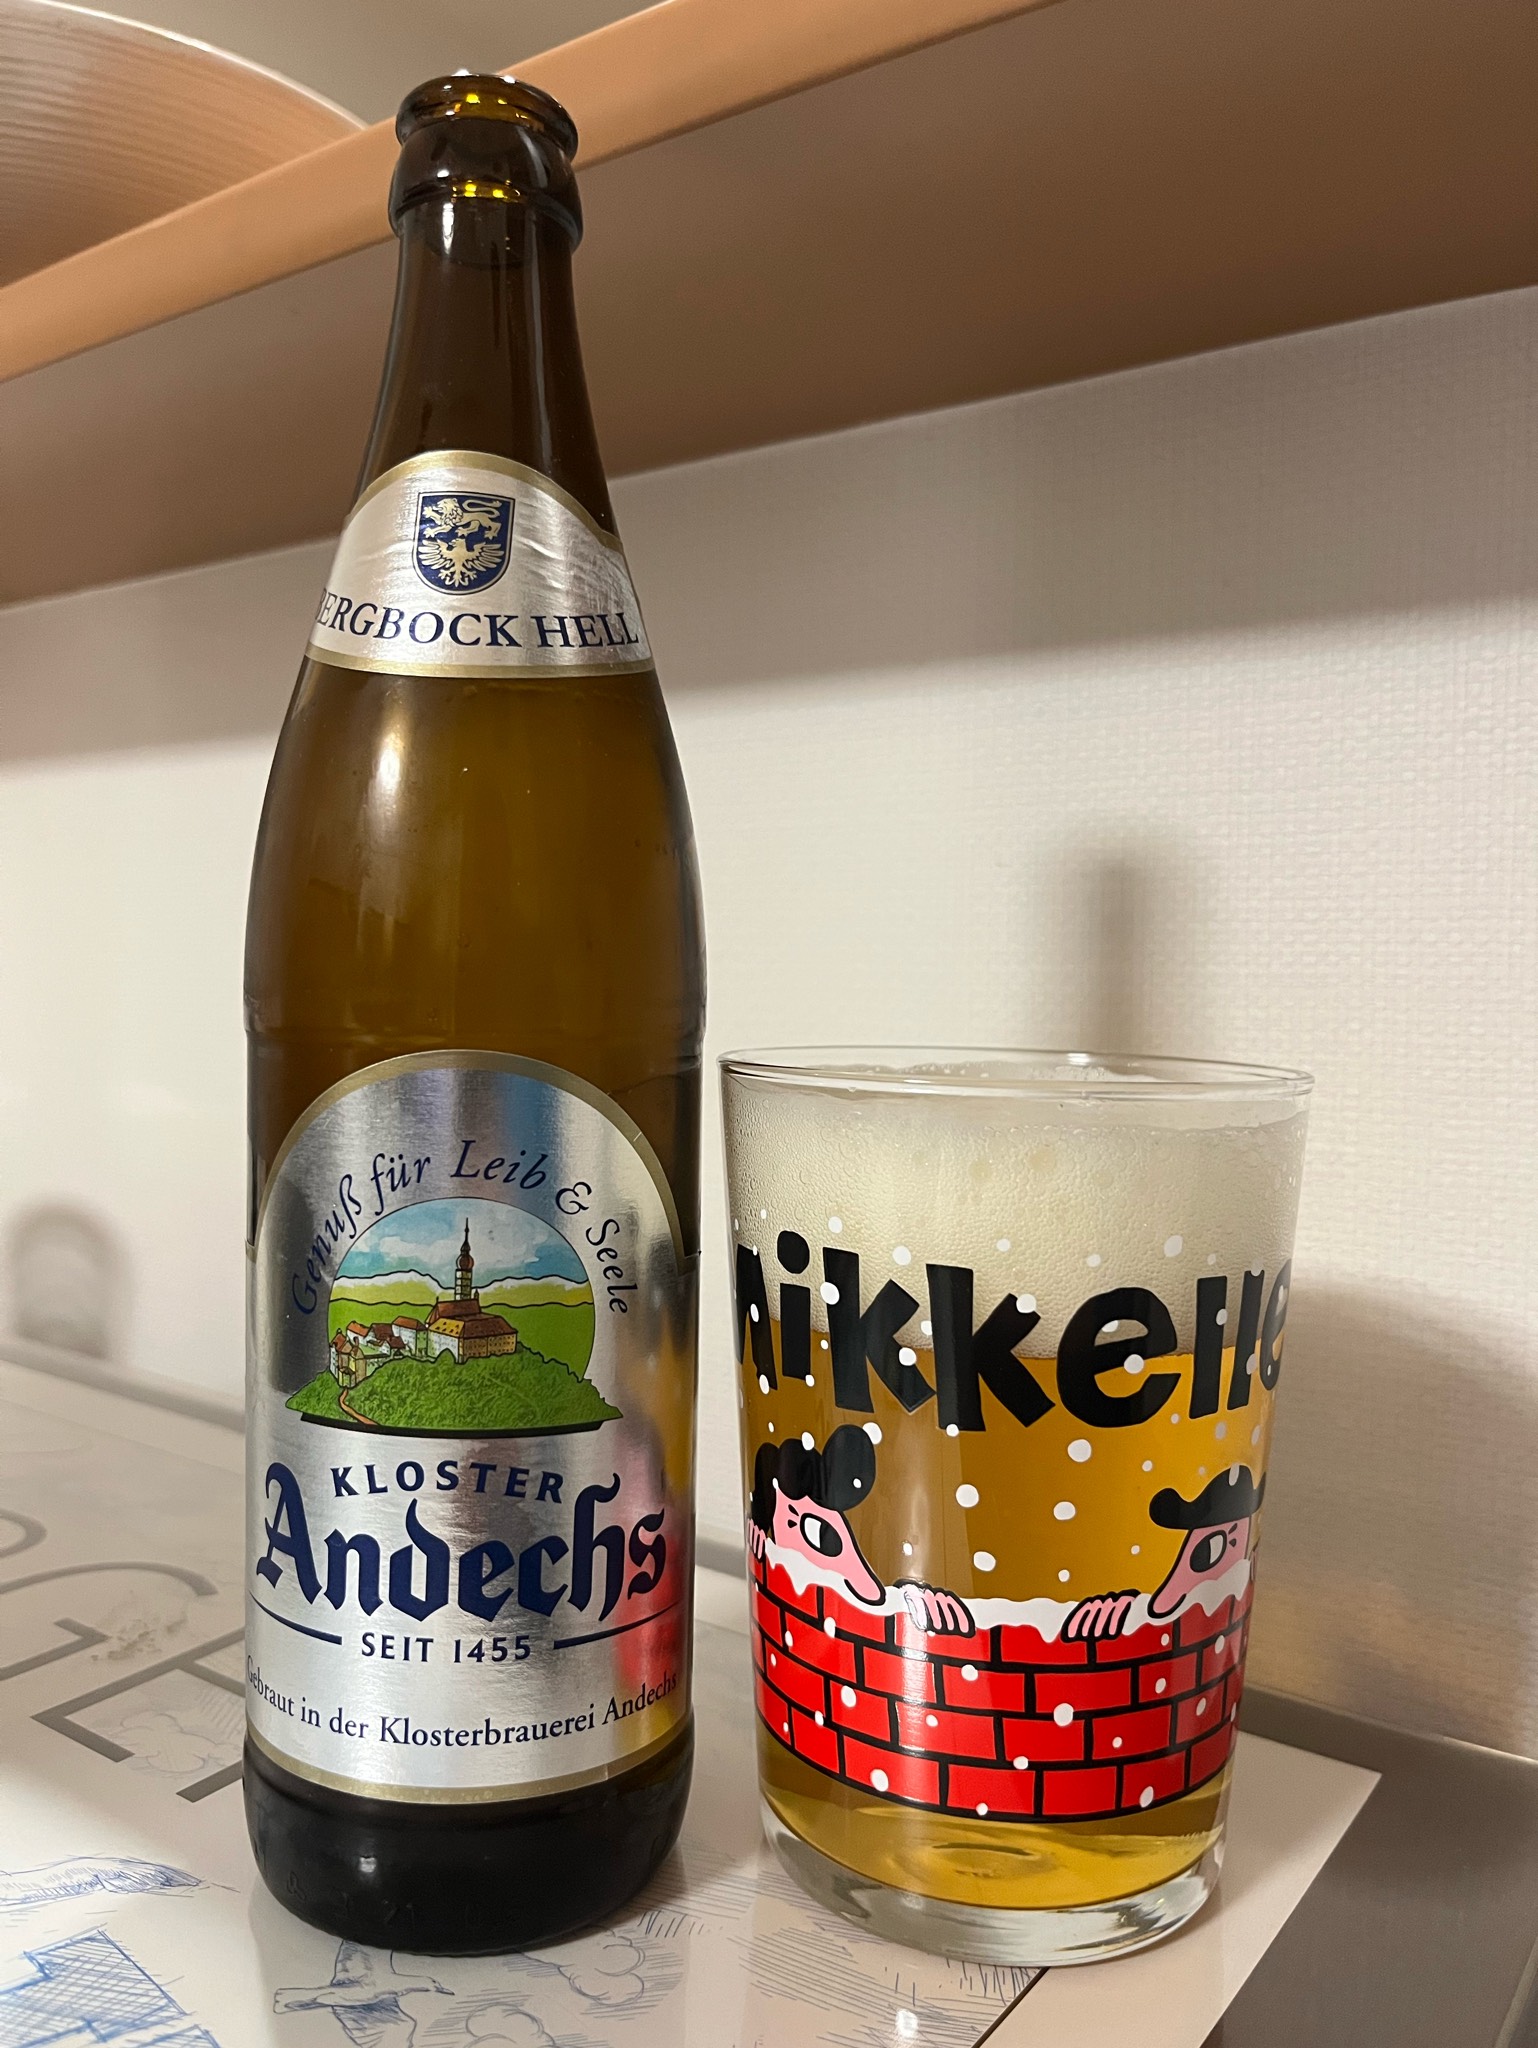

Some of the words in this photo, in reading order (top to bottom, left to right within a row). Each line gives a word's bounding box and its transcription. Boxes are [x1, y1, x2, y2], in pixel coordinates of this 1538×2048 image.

[530, 612, 639, 648] HELL
[292, 1173, 362, 1315] Genuß
[370, 1153, 431, 1216] für
[450, 1140, 549, 1190] Leib
[555, 1181, 592, 1216] &
[585, 1218, 639, 1315] Seele
[330, 1460, 564, 1504] KLOSTER
[256, 1462, 667, 1622] Andechs
[361, 1632, 434, 1663] SEIT
[453, 1635, 532, 1663] 1455
[247, 1654, 294, 1717] Gebraut
[301, 1697, 321, 1728] in
[329, 1708, 370, 1740] der
[380, 1702, 596, 1747] Klosterbrauerei
[602, 1670, 677, 1725] Andechs
